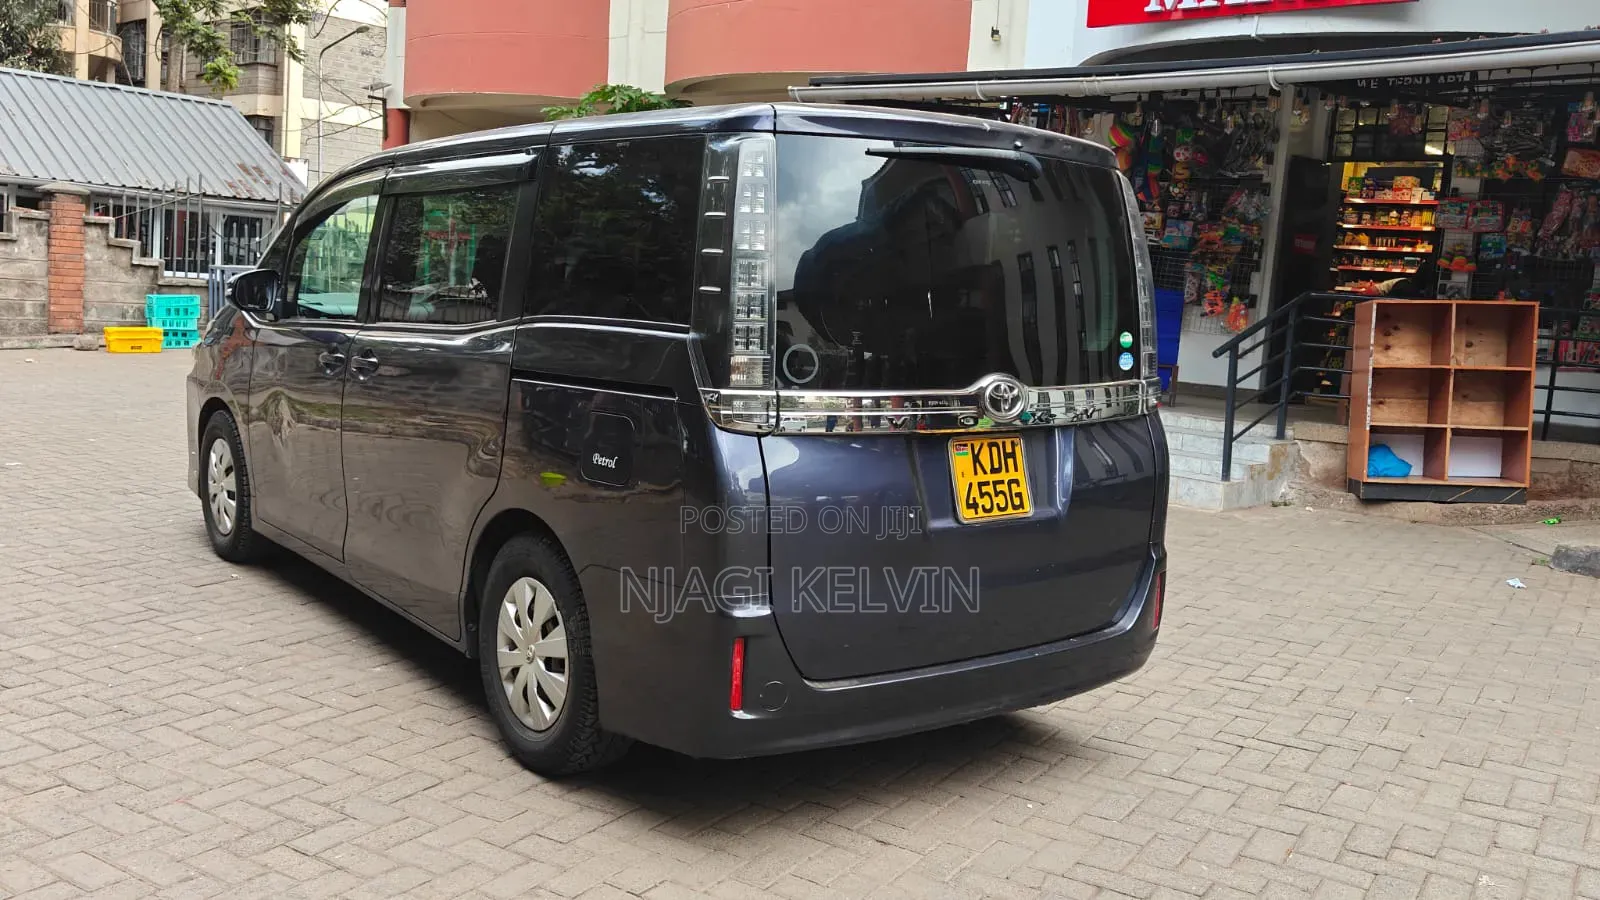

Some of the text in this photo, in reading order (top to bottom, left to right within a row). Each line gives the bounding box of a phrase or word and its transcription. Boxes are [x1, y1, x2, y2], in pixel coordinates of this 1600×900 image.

[592, 452, 619, 469] Petrol
[970, 440, 1019, 476] KDH
[965, 478, 1025, 515] 455G
